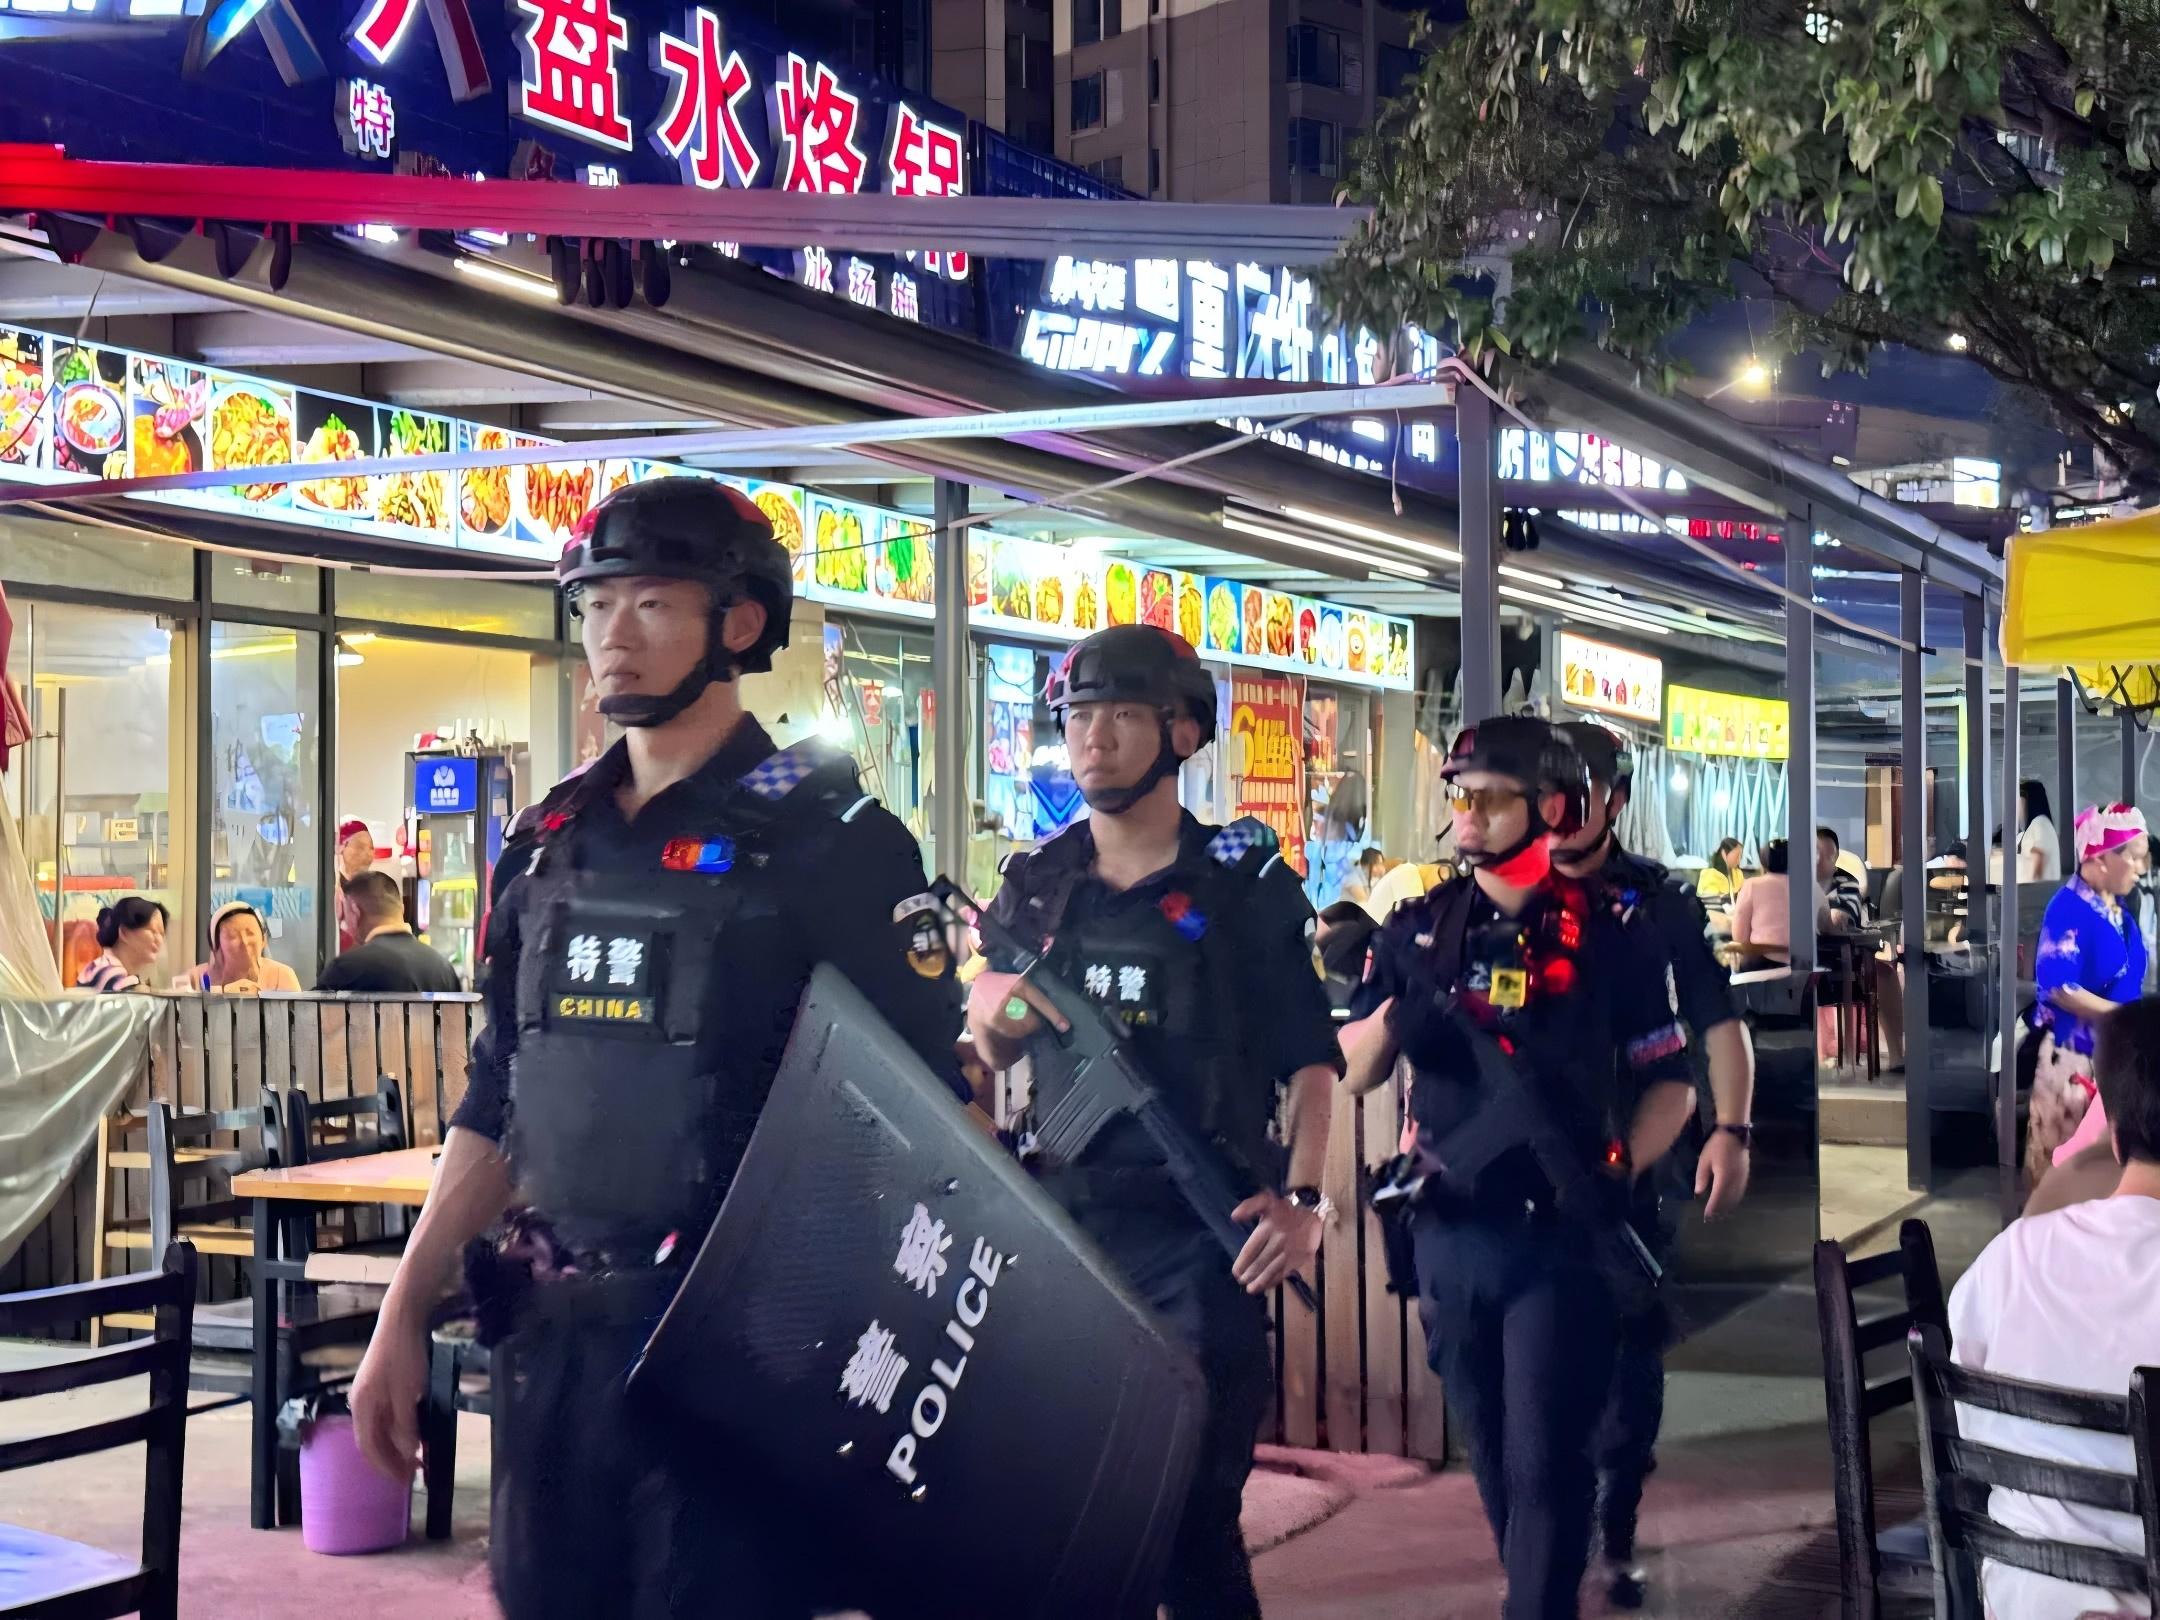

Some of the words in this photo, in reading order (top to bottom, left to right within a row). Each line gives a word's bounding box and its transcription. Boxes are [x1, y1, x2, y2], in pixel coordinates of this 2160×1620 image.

[349, 79, 395, 158] 特
[567, 934, 644, 986] 特警
[1085, 964, 1147, 1002] 特警
[886, 1235, 1003, 1484] POLICE
